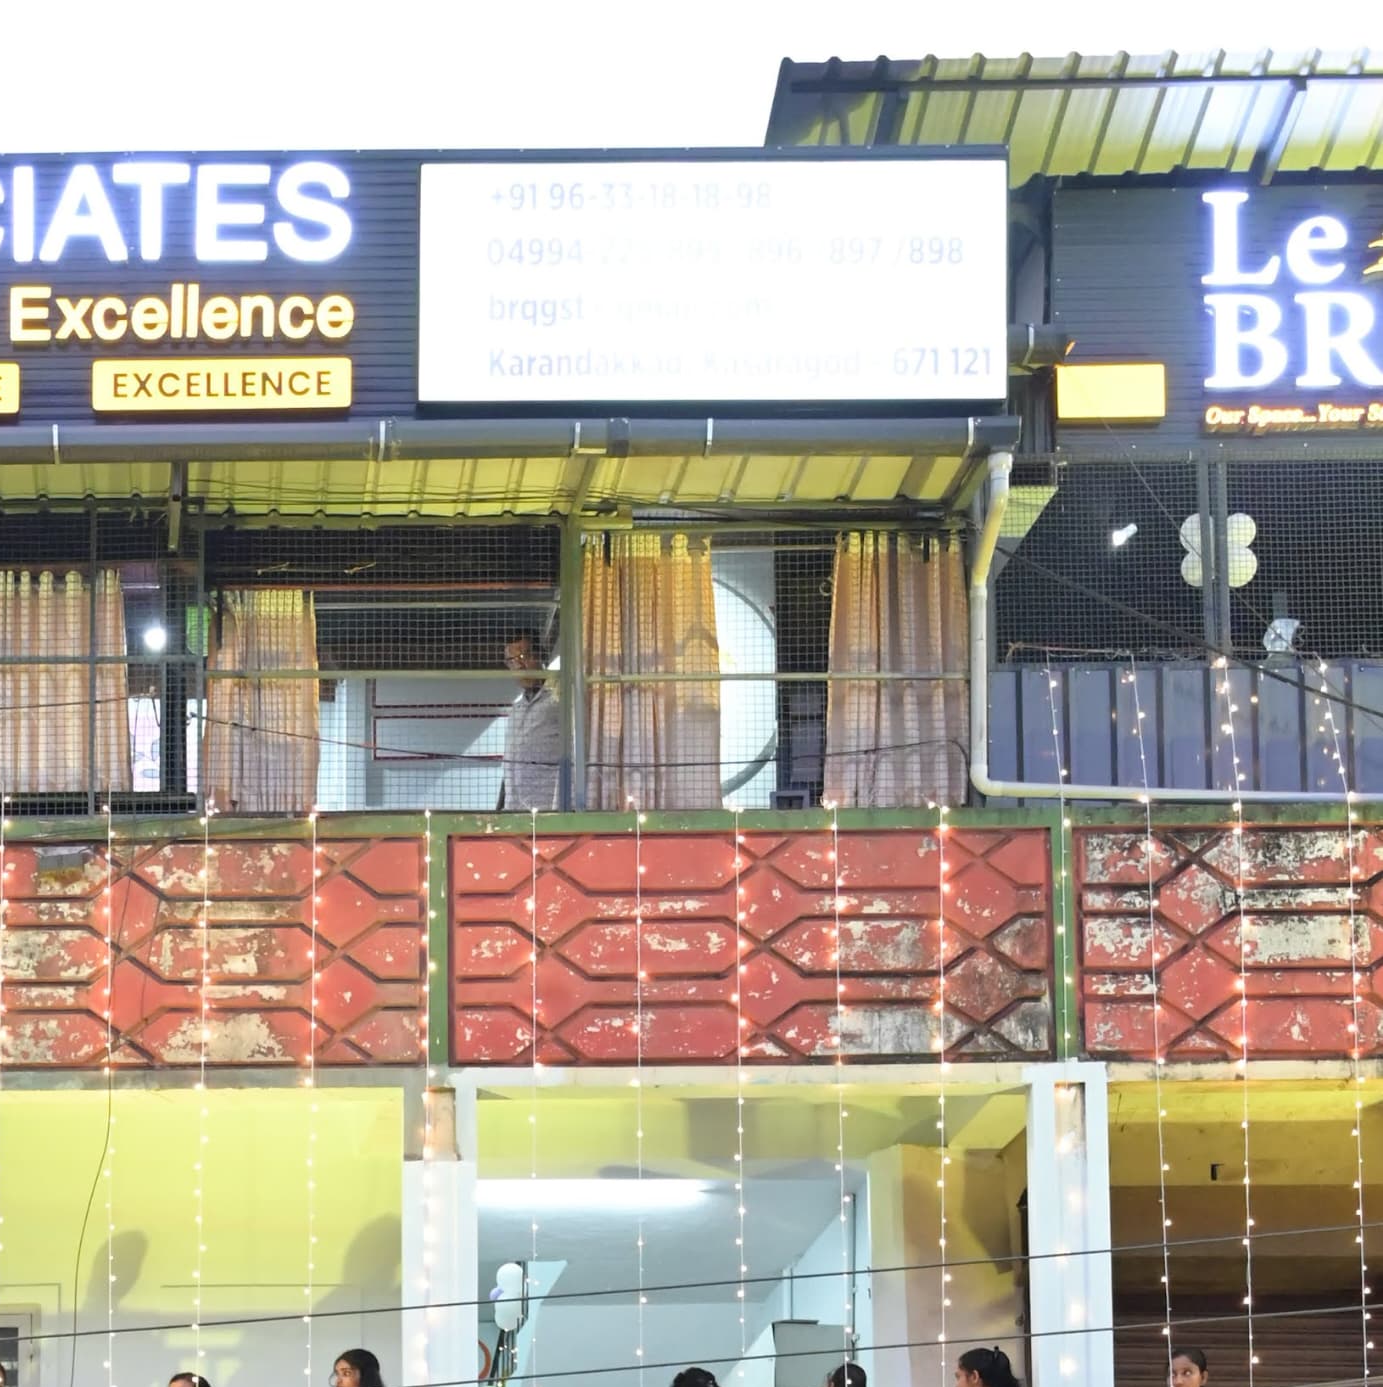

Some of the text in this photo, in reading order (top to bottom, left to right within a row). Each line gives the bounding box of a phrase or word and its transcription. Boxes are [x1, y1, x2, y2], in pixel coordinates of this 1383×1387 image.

[1201, 191, 1349, 286] Le
[10, 282, 355, 342] Excellence
[112, 371, 332, 399] EXCELLENCE
[1318, 403, 1366, 423] Your
